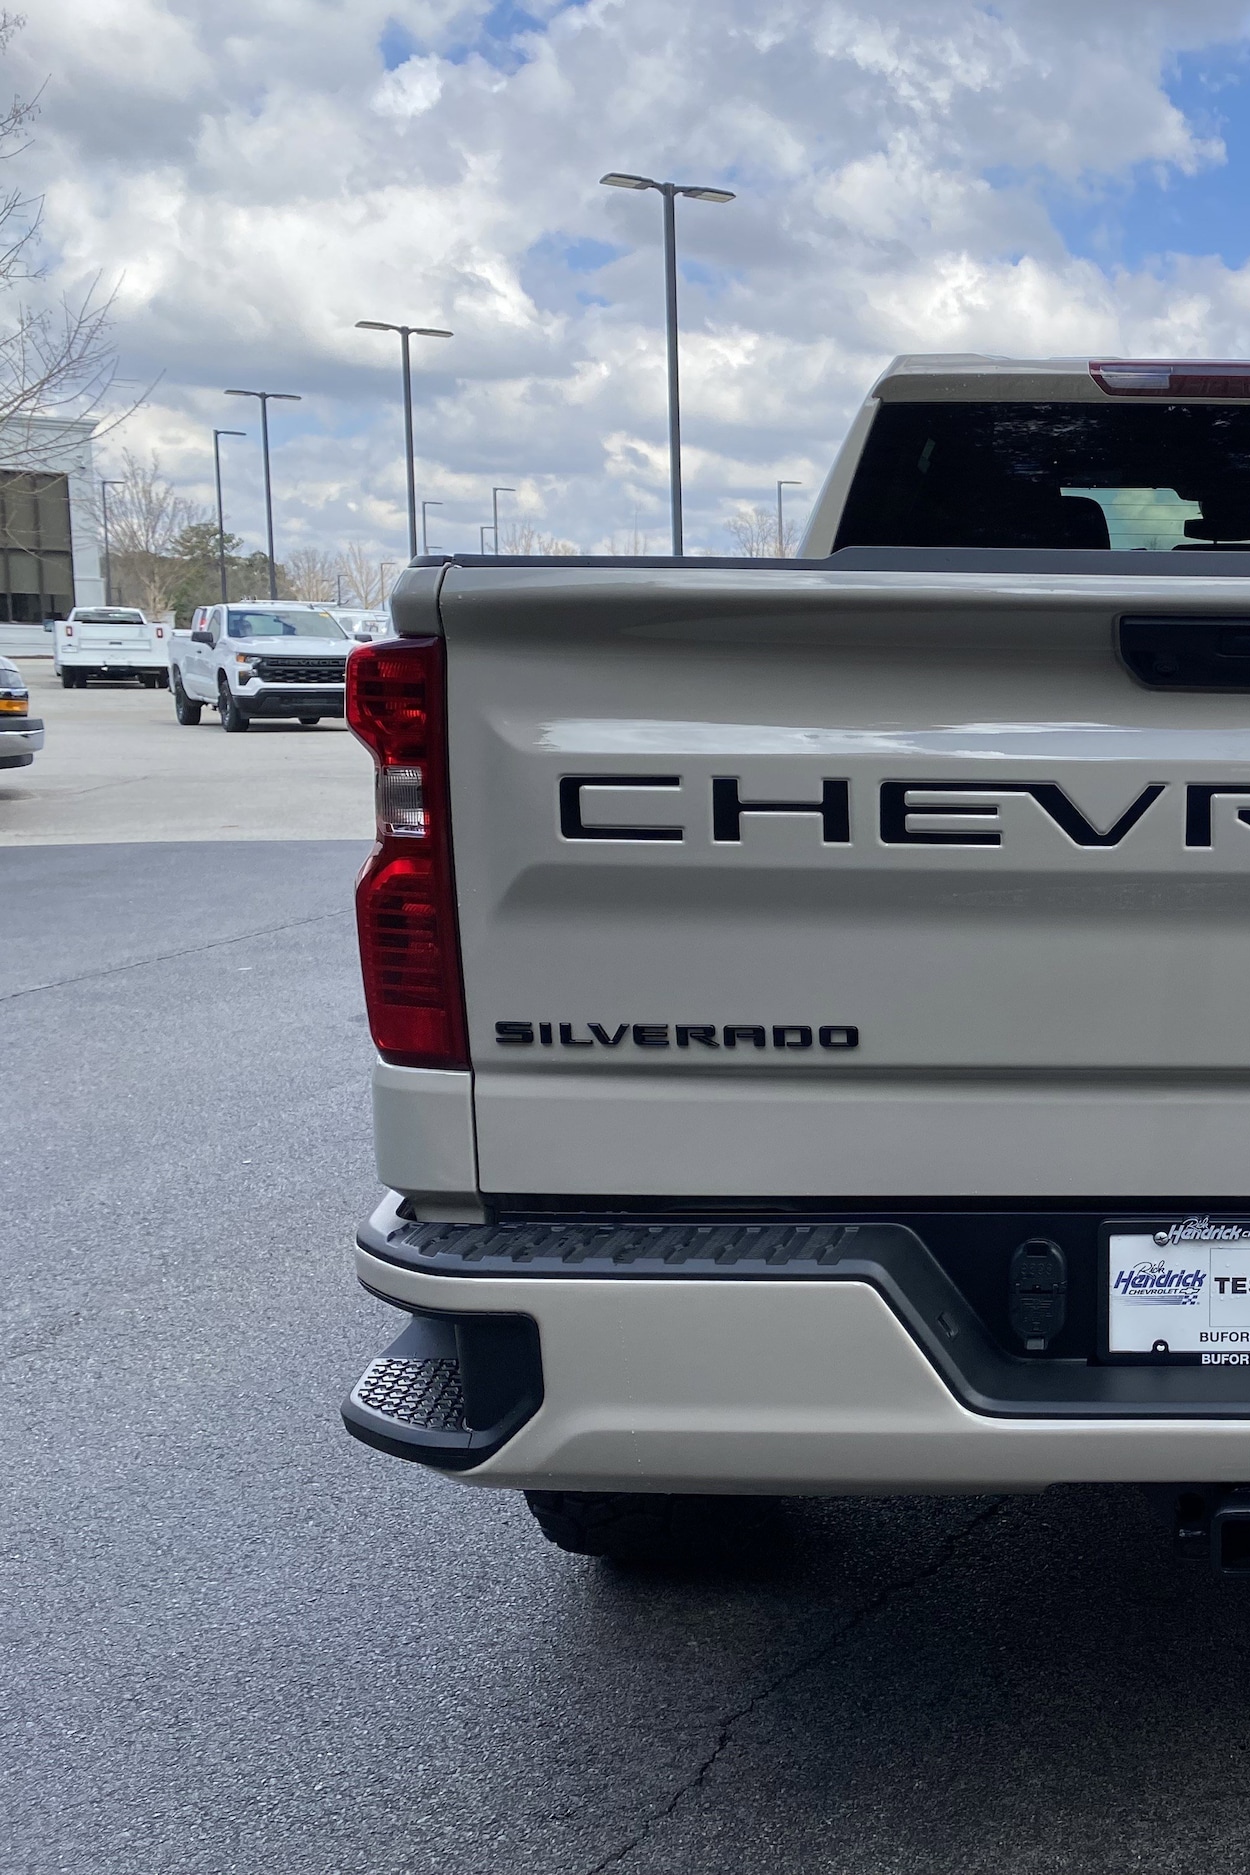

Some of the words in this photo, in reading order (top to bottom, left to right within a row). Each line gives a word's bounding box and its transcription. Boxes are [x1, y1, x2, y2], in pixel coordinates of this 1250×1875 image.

[495, 1021, 859, 1048] SILVERADO
[1183, 1215, 1209, 1229] Rick
[1168, 1224, 1242, 1245] Hendrick
[1133, 1260, 1166, 1280] Rick
[1113, 1269, 1207, 1295] Hendrick
